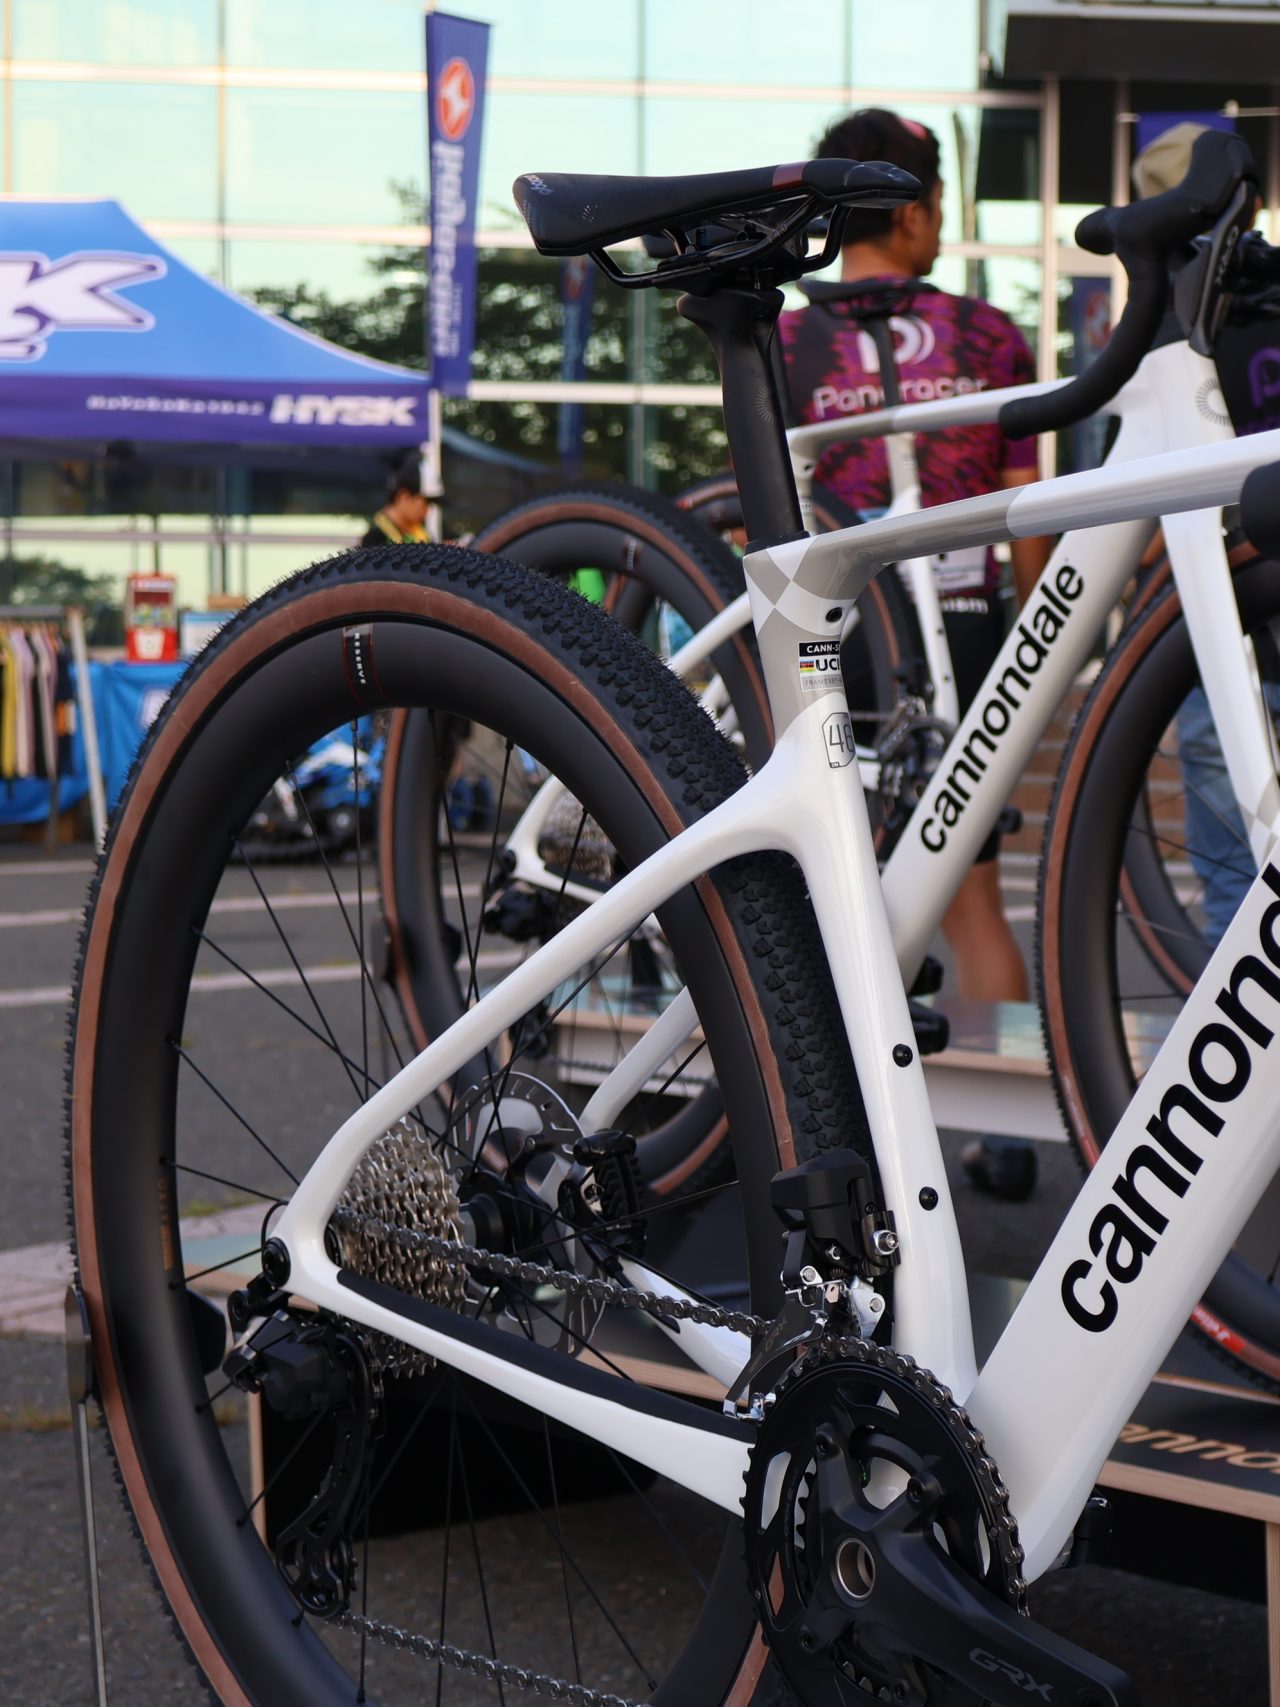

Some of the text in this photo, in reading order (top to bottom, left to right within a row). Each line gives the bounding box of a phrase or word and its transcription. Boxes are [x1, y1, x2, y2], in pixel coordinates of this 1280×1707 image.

[270, 394, 417, 427] HYSK
[919, 564, 1085, 854] cannondale
[969, 1647, 1054, 1703] GRX
